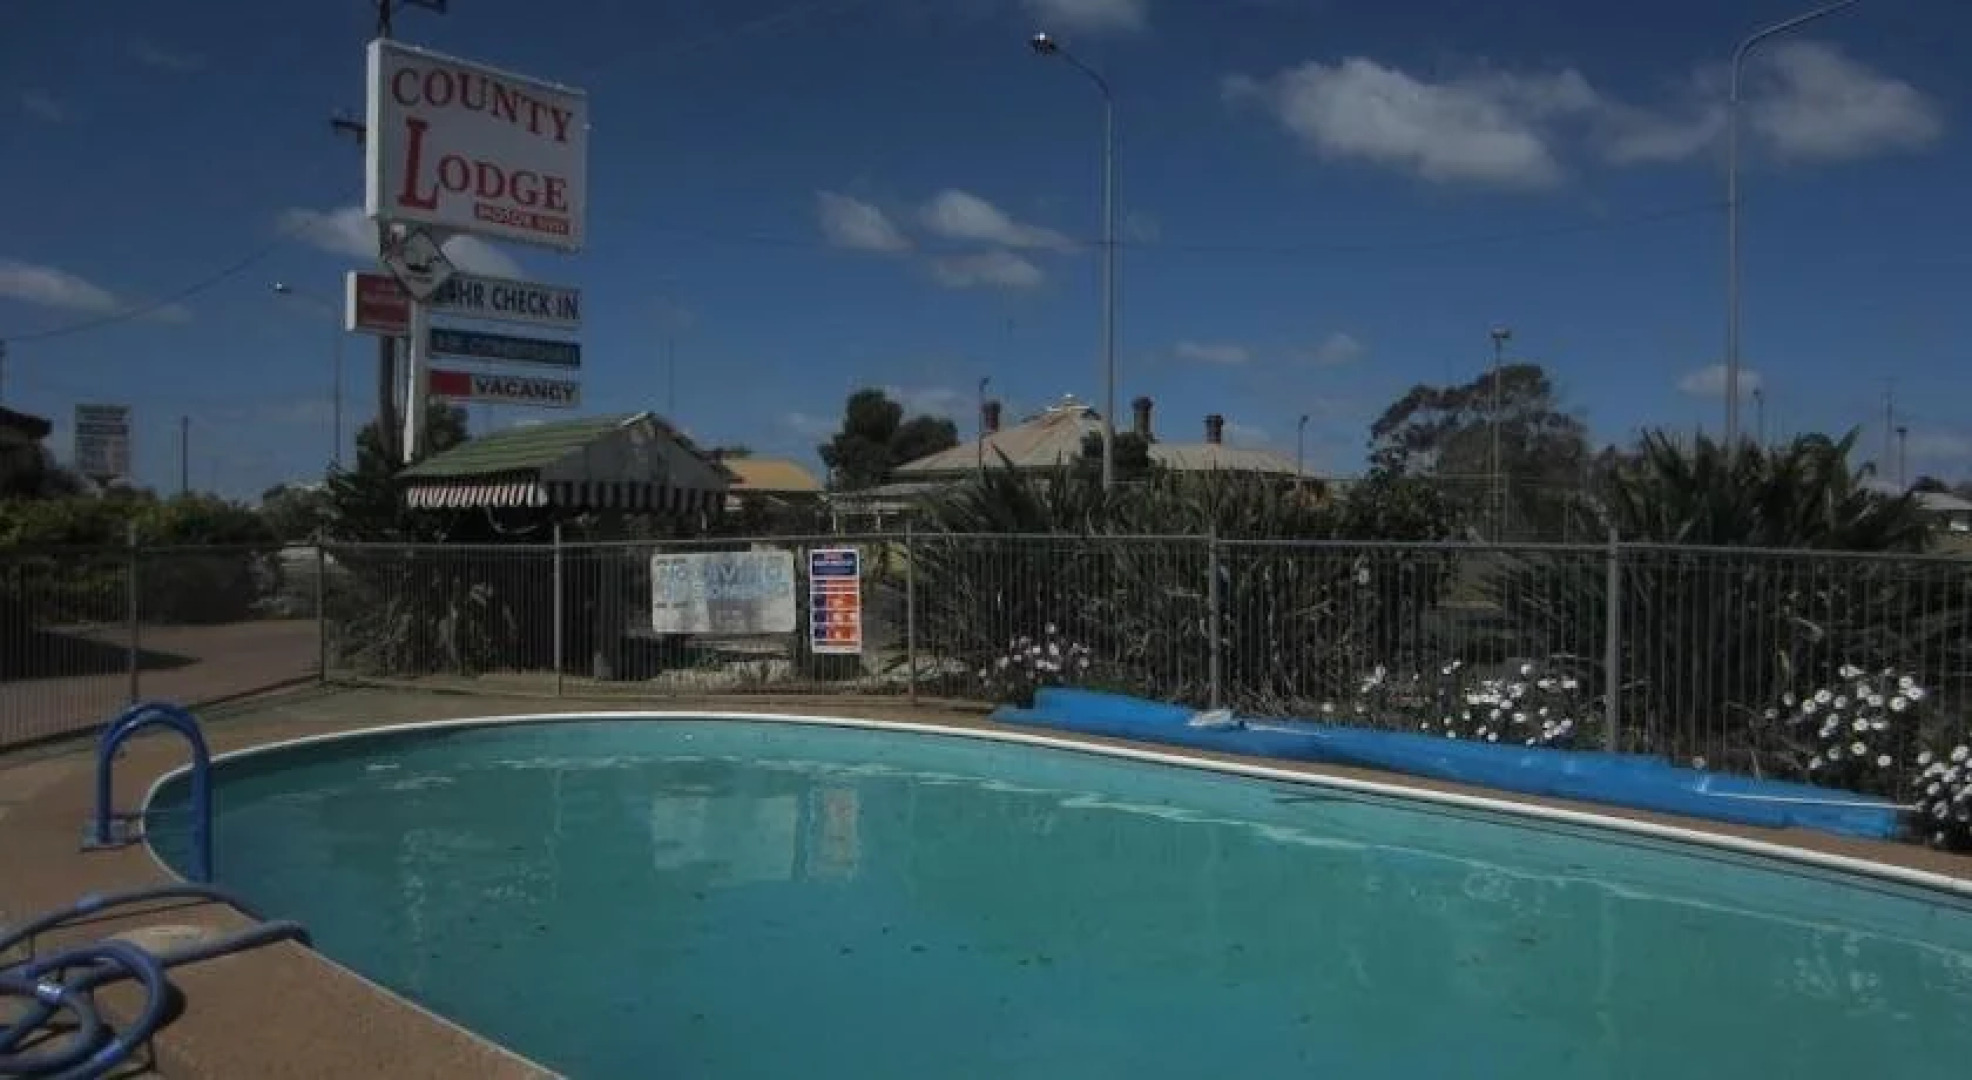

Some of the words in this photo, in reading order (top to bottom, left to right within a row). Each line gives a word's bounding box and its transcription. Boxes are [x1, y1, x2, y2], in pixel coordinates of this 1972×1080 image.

[391, 67, 573, 141] COUNTY
[491, 286, 548, 318] CHECK
[556, 294, 578, 320] IN
[475, 378, 575, 403] VACANCY
